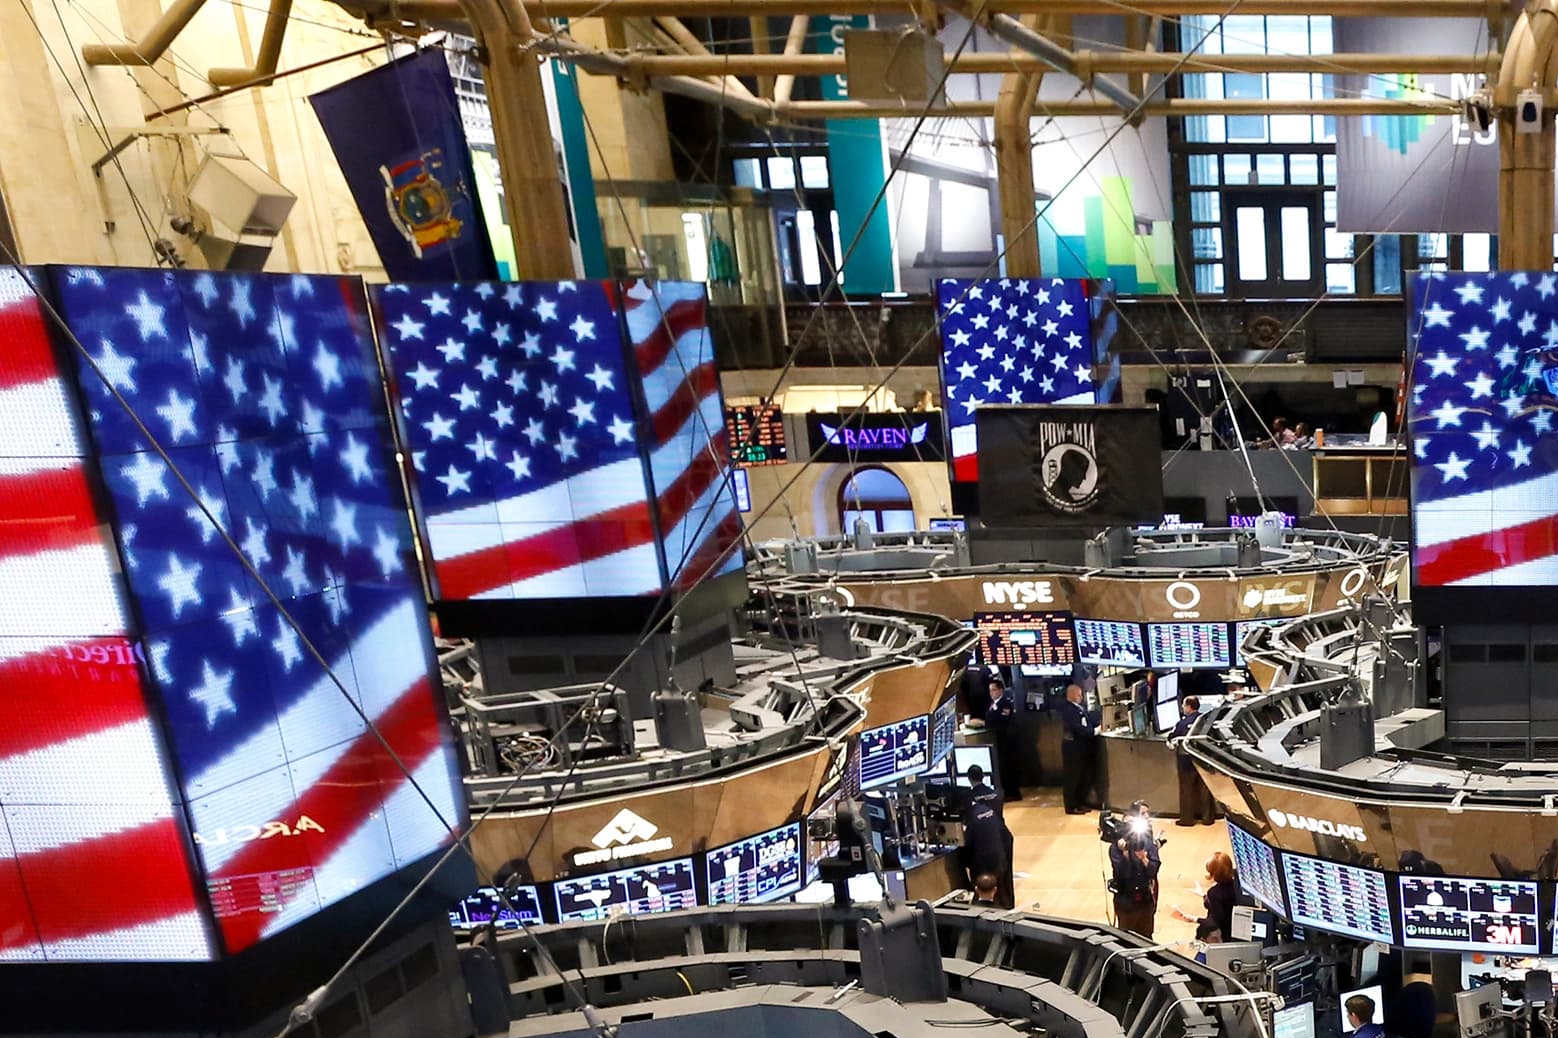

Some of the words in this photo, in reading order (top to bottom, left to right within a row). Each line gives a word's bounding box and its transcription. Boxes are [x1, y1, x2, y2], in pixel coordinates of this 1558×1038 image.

[844, 428, 908, 444] RAVEN
[1039, 421, 1067, 459] POW
[1073, 423, 1097, 459] MIA
[982, 581, 1054, 604] NYSE
[1286, 813, 1368, 843] BARCLAYS
[1486, 925, 1522, 945] 3M
